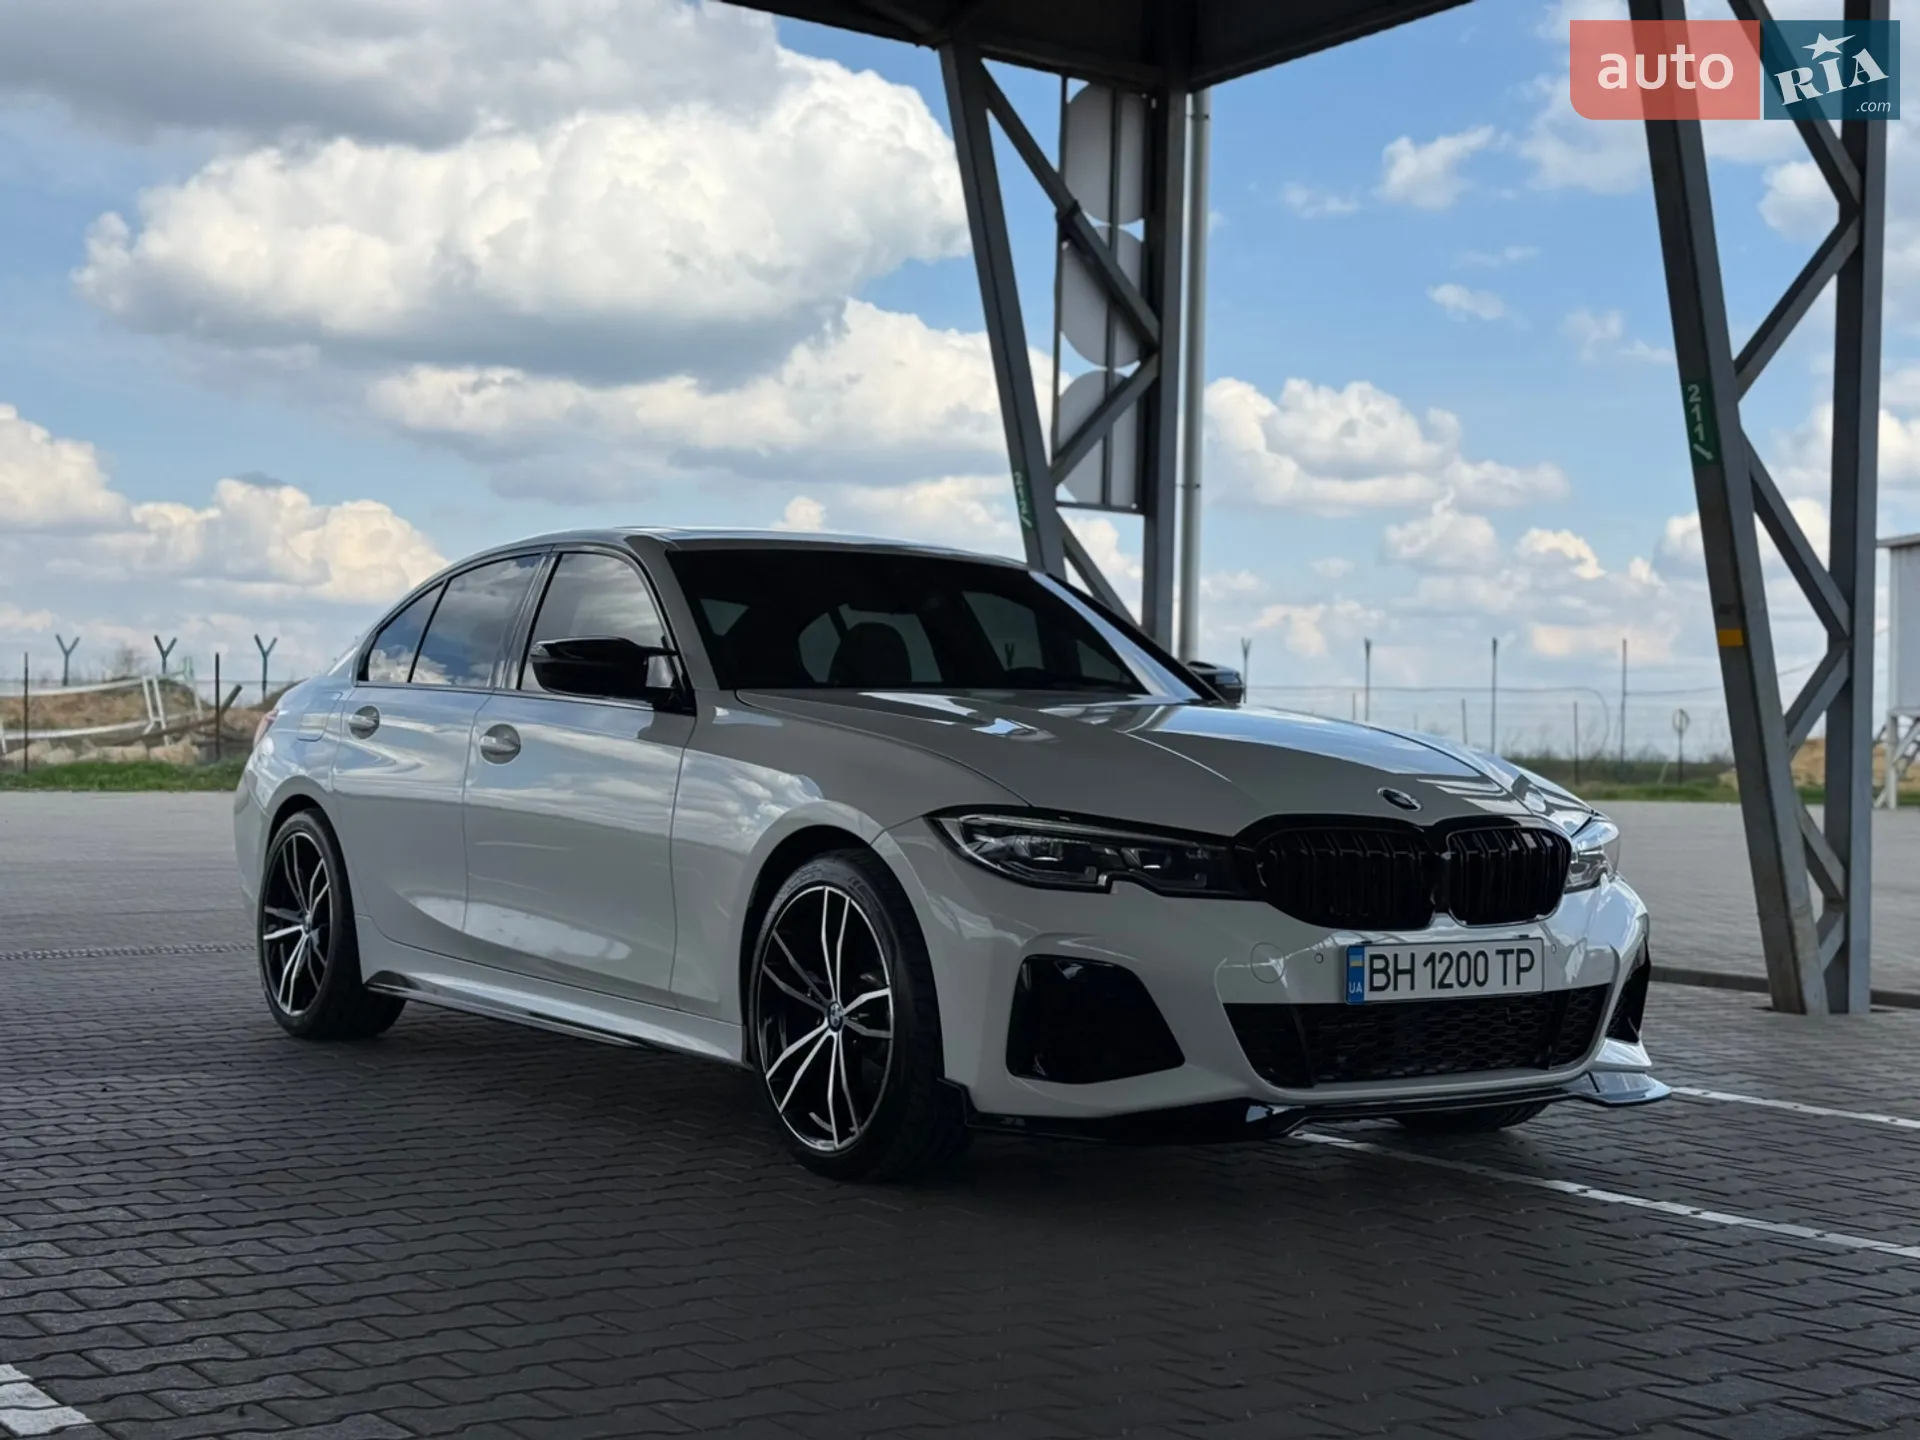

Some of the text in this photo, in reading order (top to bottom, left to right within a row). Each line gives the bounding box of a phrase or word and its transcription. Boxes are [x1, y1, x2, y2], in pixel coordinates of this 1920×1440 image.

[1369, 948, 1535, 991] BH 1200 TP
[1348, 982, 1363, 993] UA
